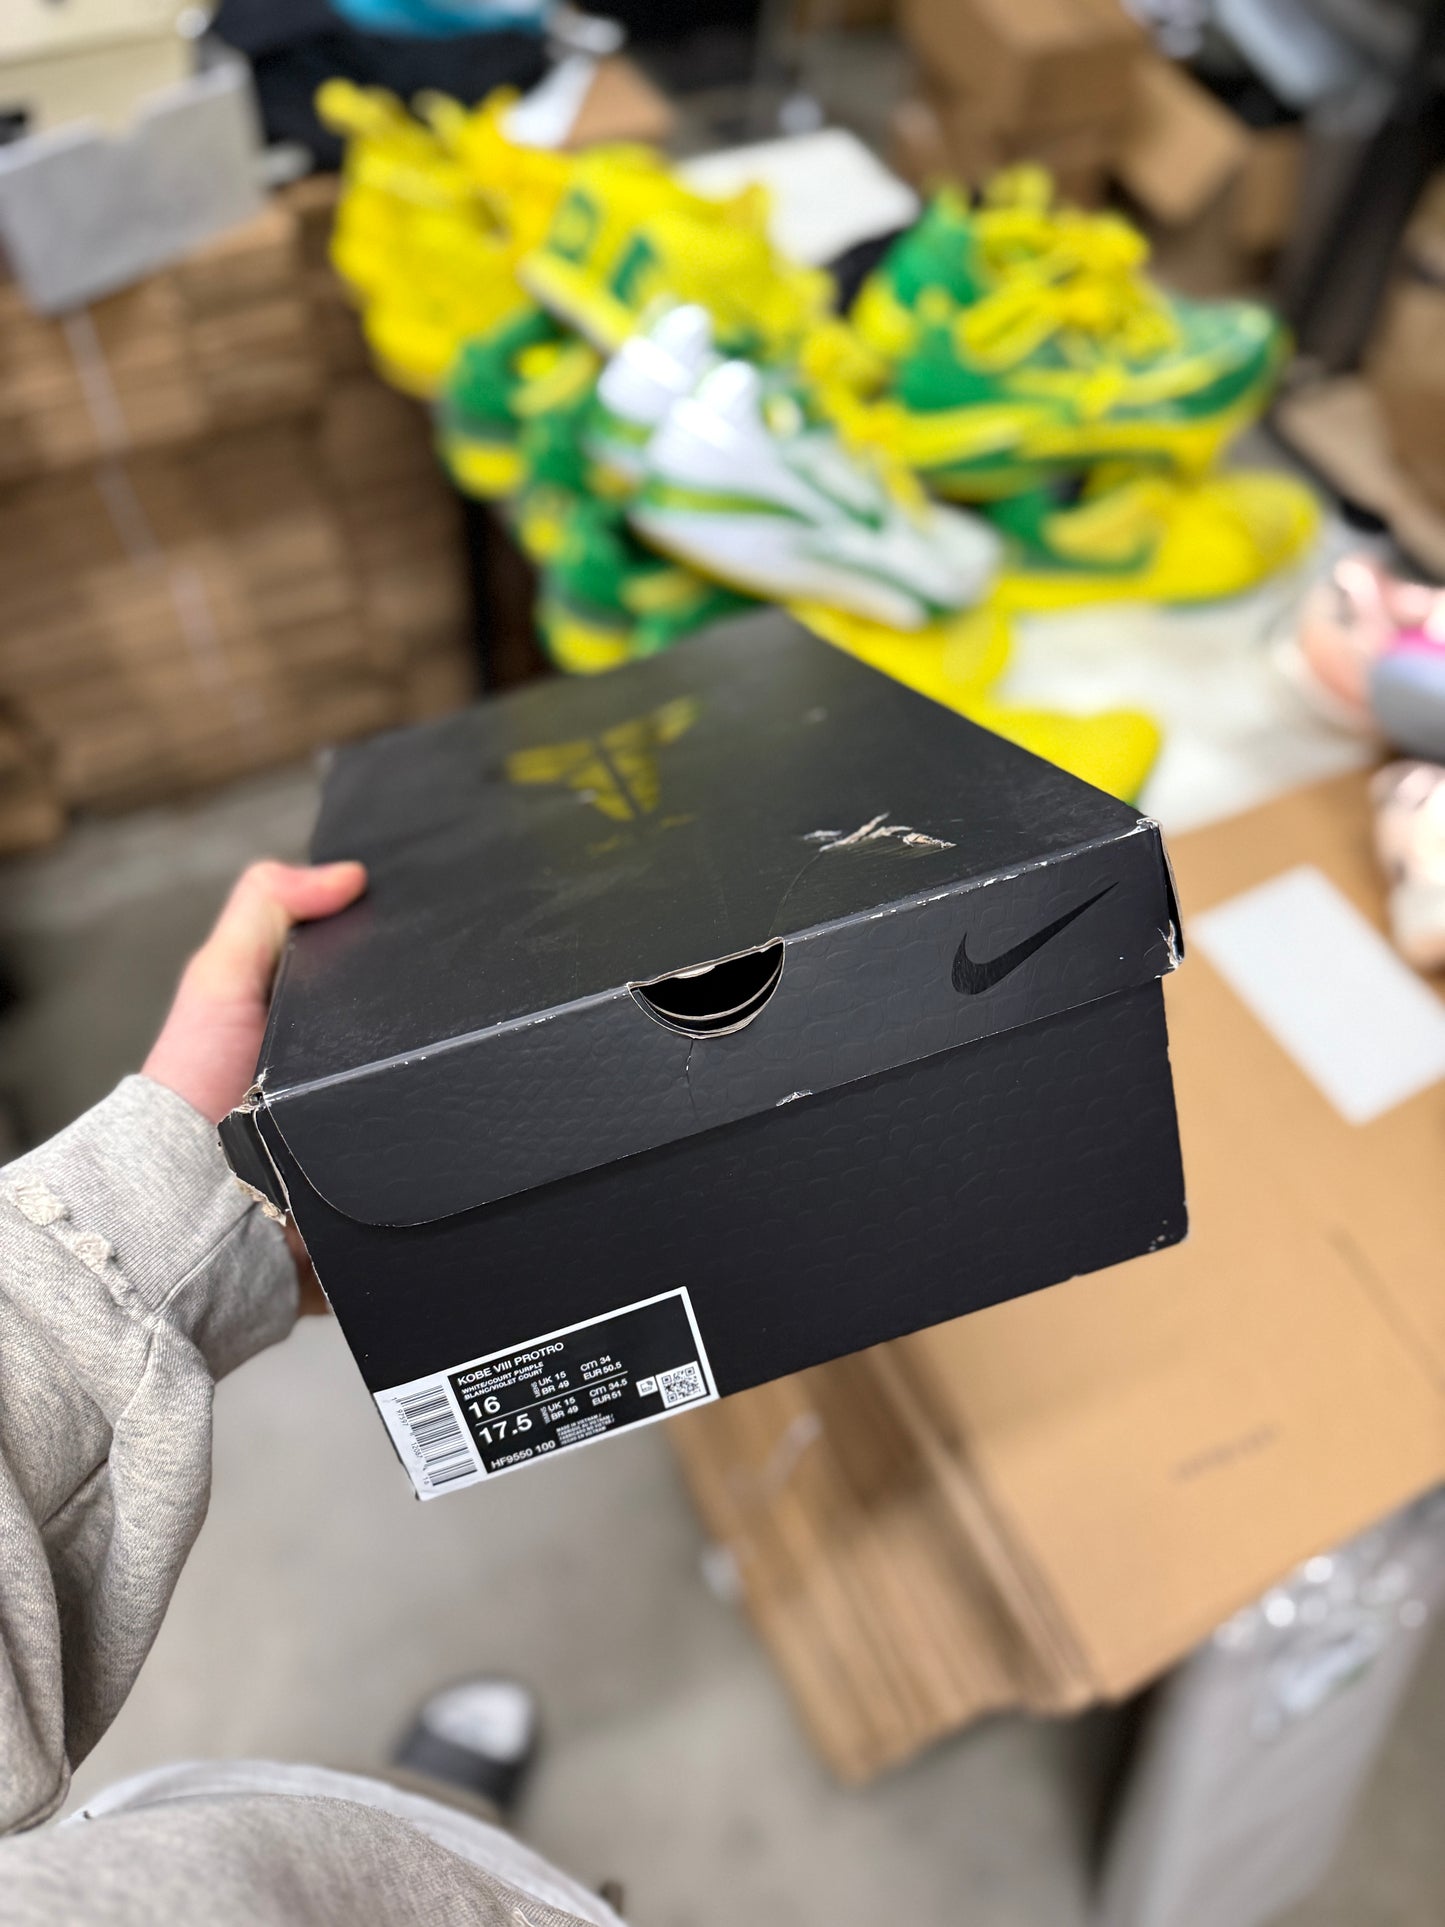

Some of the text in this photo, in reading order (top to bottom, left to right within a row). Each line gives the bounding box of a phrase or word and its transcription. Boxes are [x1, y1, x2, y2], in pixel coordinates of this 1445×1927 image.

[457, 1342, 564, 1386] KOBE VIII PROTRO
[580, 1355, 611, 1371] cm 34
[583, 1361, 622, 1380] EUR 50.5
[461, 1361, 544, 1394] WHITE/COURT PURPLE
[464, 1368, 542, 1400] BLANC/VIOLET COURT
[538, 1371, 566, 1386] UK 15
[541, 1380, 569, 1395] BR 49
[589, 1378, 628, 1397] cm 34.5
[469, 1396, 500, 1418] 16
[548, 1397, 576, 1412] UK 15
[592, 1390, 621, 1406] EUR 51
[551, 1405, 579, 1420] BR 49
[479, 1413, 532, 1443] 17.5
[491, 1440, 556, 1469] HF9550 100
